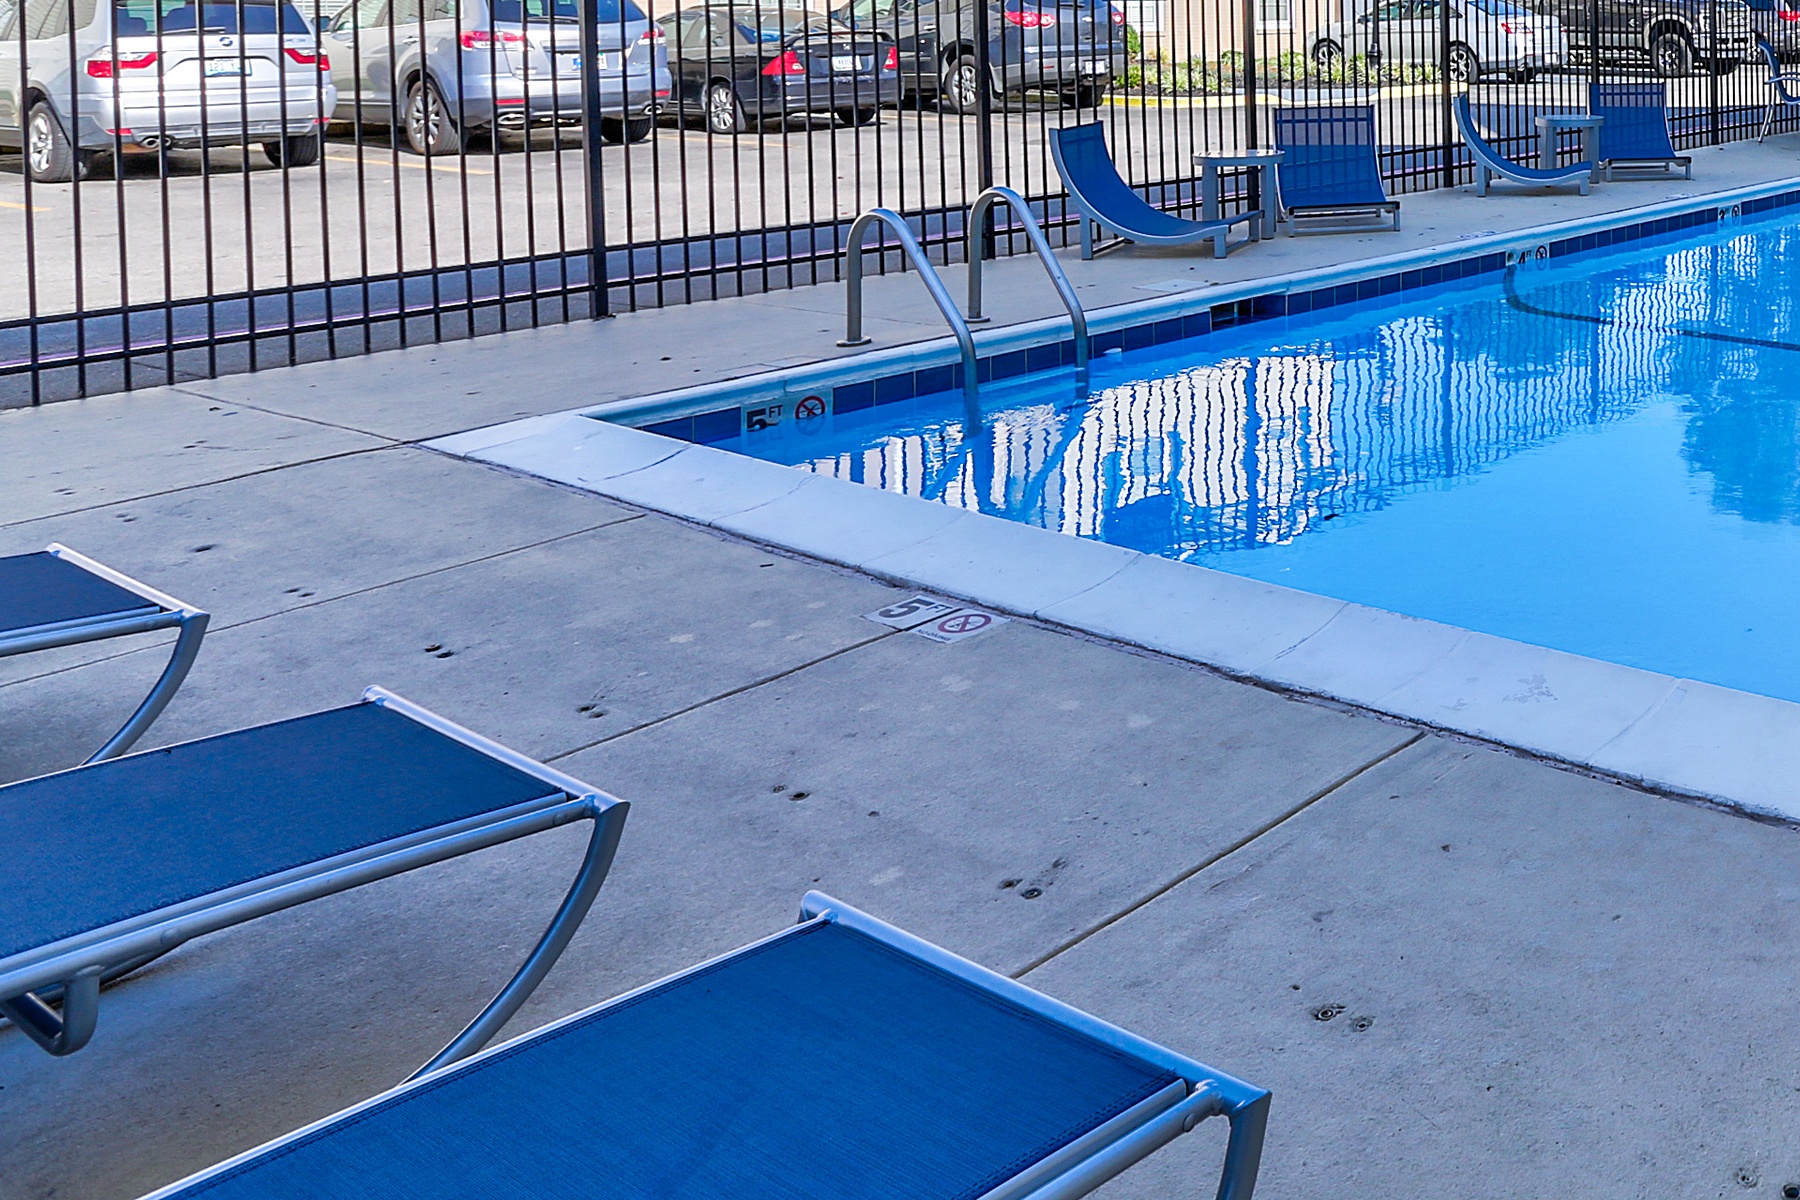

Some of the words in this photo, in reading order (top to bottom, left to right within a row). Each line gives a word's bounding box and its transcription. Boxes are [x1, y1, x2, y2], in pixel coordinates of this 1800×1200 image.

[746, 407, 768, 433] 5
[768, 404, 784, 419] FT
[878, 598, 935, 619] 5
[926, 603, 953, 613] FT
